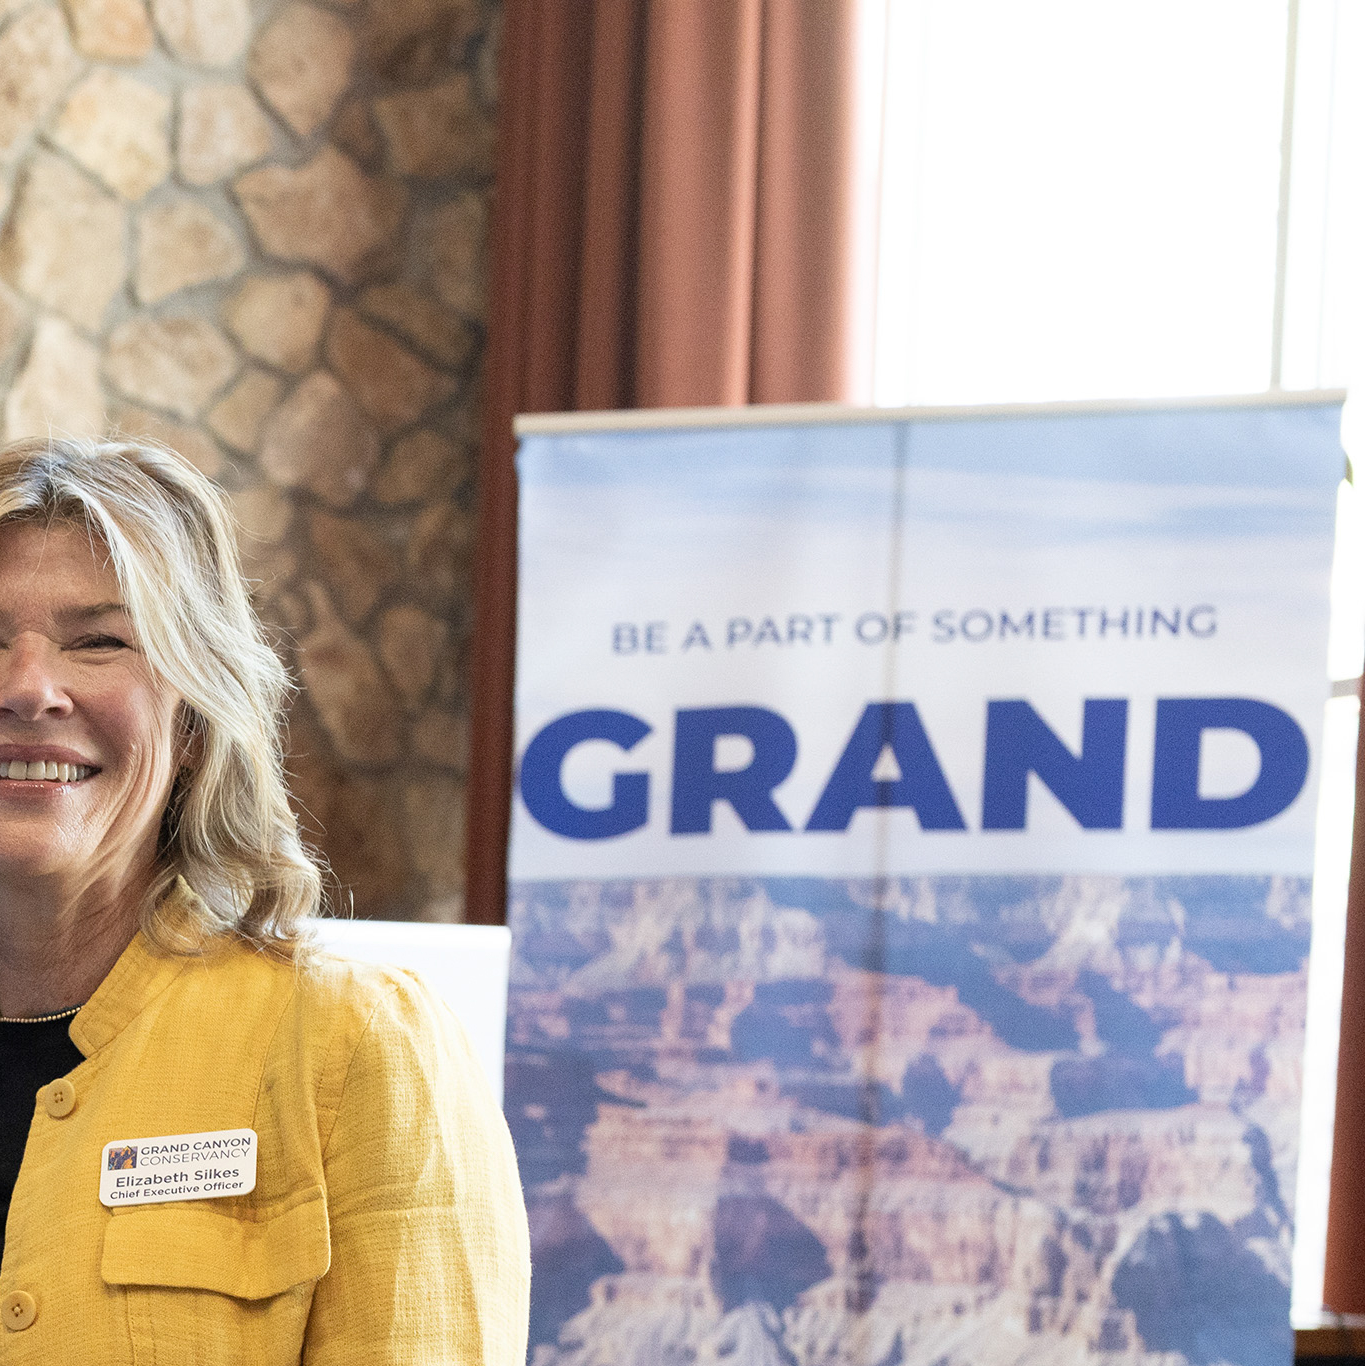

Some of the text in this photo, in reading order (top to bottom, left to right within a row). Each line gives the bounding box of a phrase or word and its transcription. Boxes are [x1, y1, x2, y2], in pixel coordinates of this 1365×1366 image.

[610, 604, 1219, 655] BE A PART OF SOMETHING
[518, 696, 1311, 842] GRAND
[141, 1137, 251, 1156] GRAND CANYON
[140, 1147, 251, 1167] CONSERVANCY
[115, 1168, 240, 1188] Elizabeth Silkes
[110, 1180, 244, 1200] Chief Executive Officer
